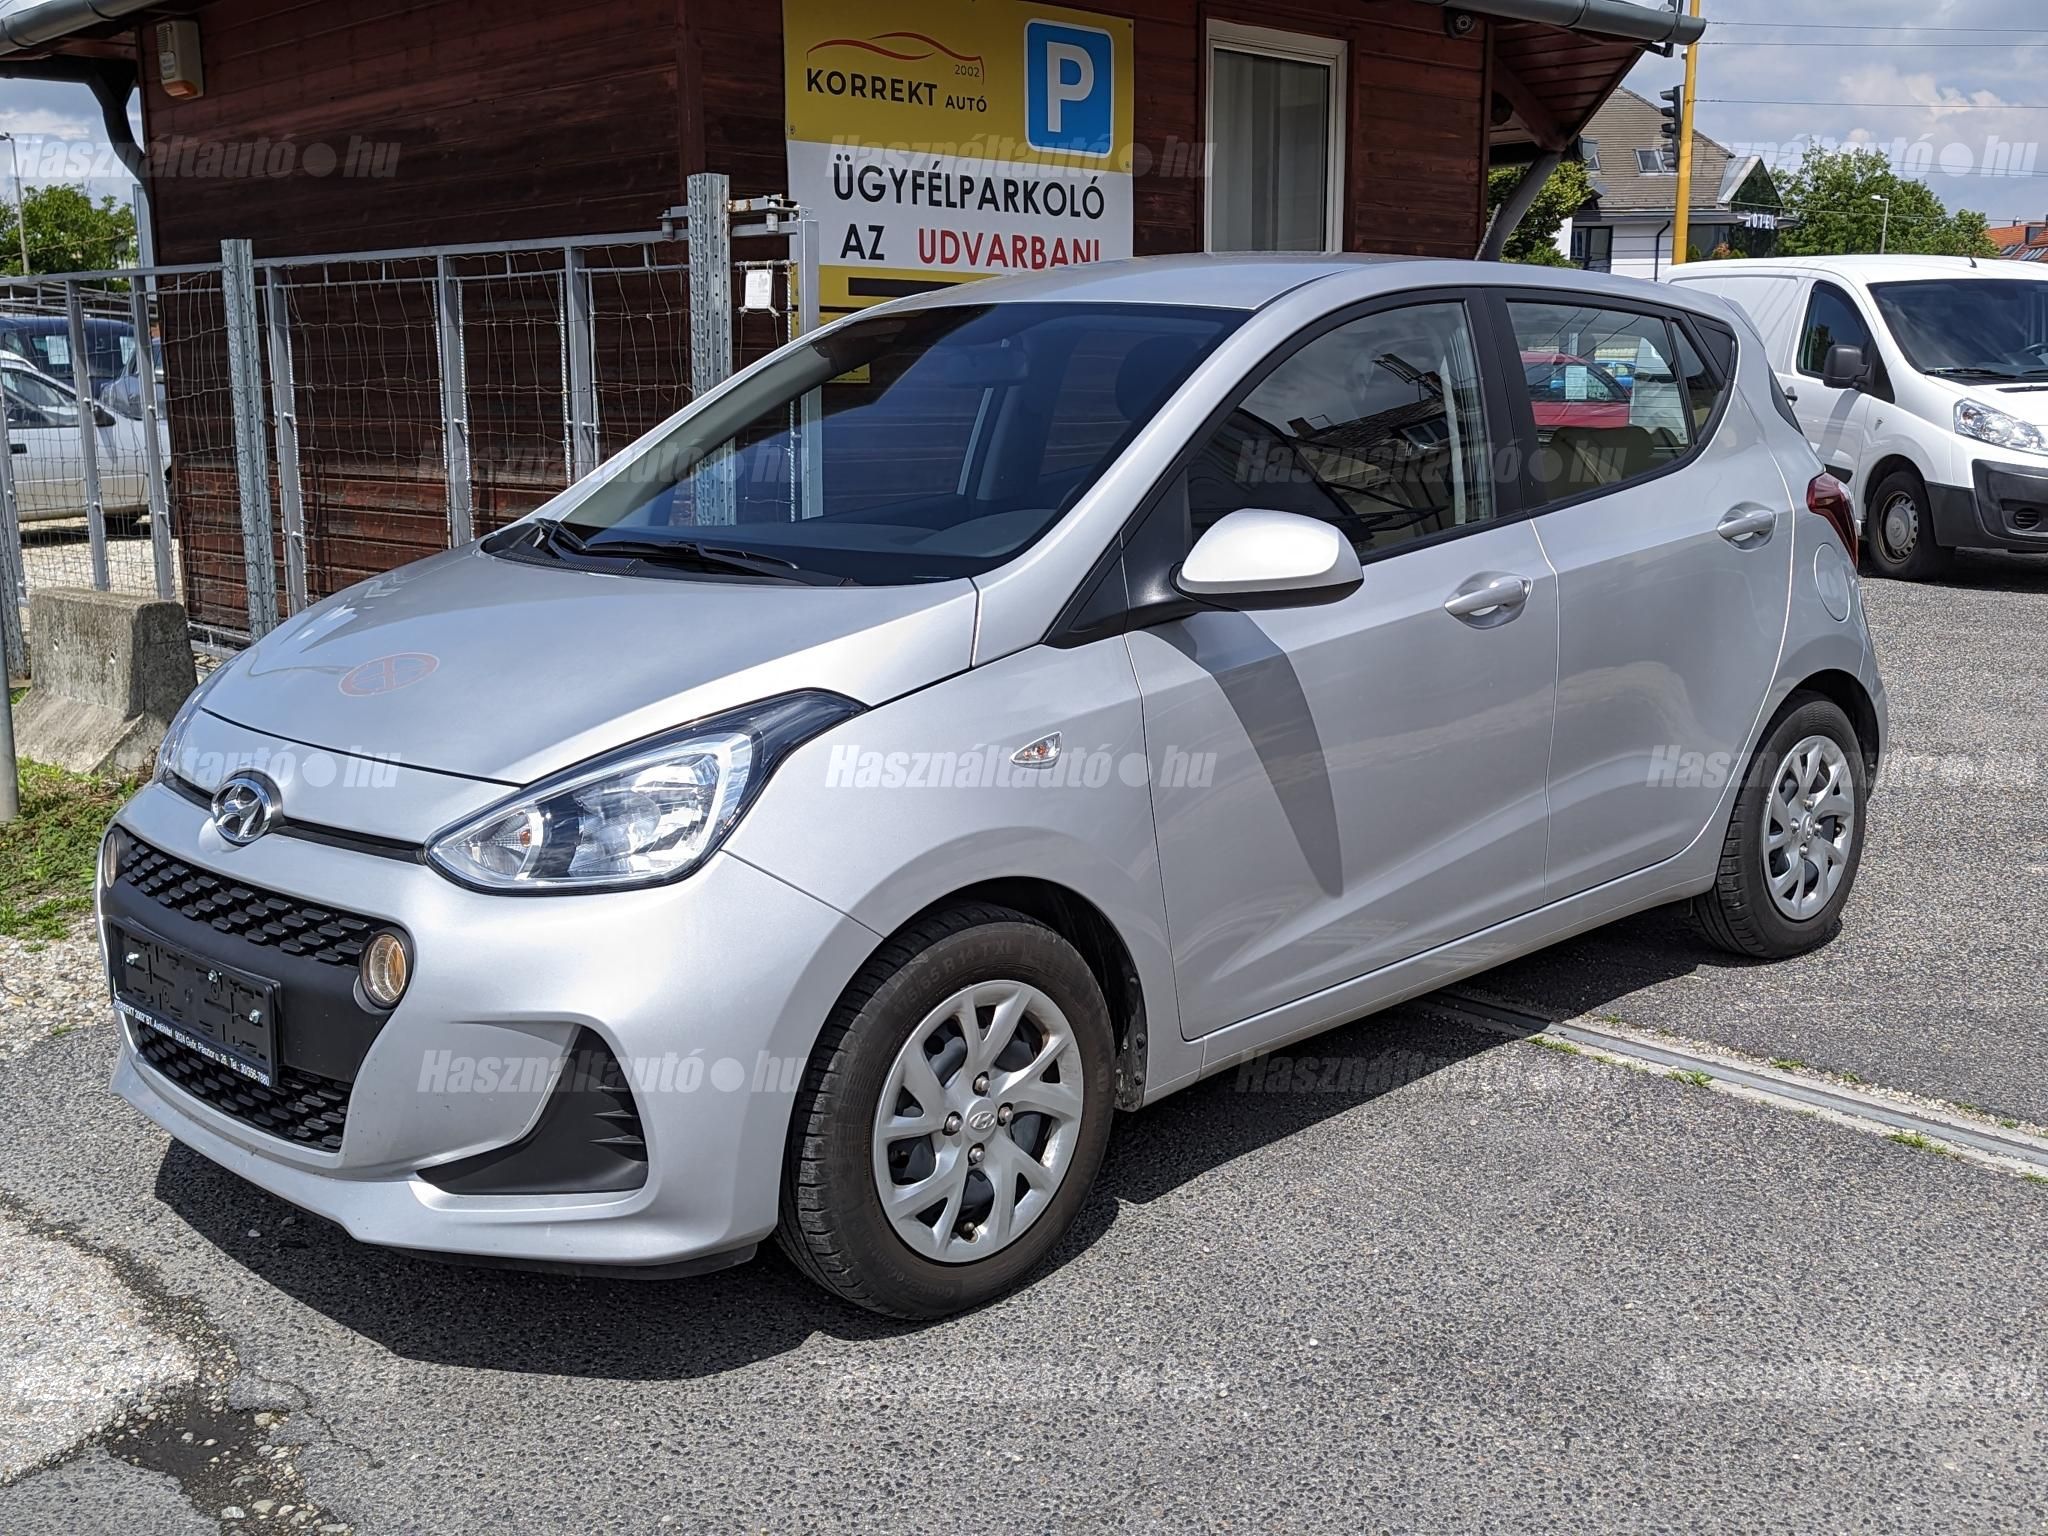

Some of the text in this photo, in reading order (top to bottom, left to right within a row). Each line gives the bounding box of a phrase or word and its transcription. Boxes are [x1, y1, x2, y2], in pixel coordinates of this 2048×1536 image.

[806, 67, 987, 112] KORREKT AUTÓ
[954, 64, 980, 77] 2002
[1047, 41, 1095, 134] P
[833, 153, 1105, 220] ÜGYFÉLPARKOLÓ
[840, 223, 885, 261] AZ
